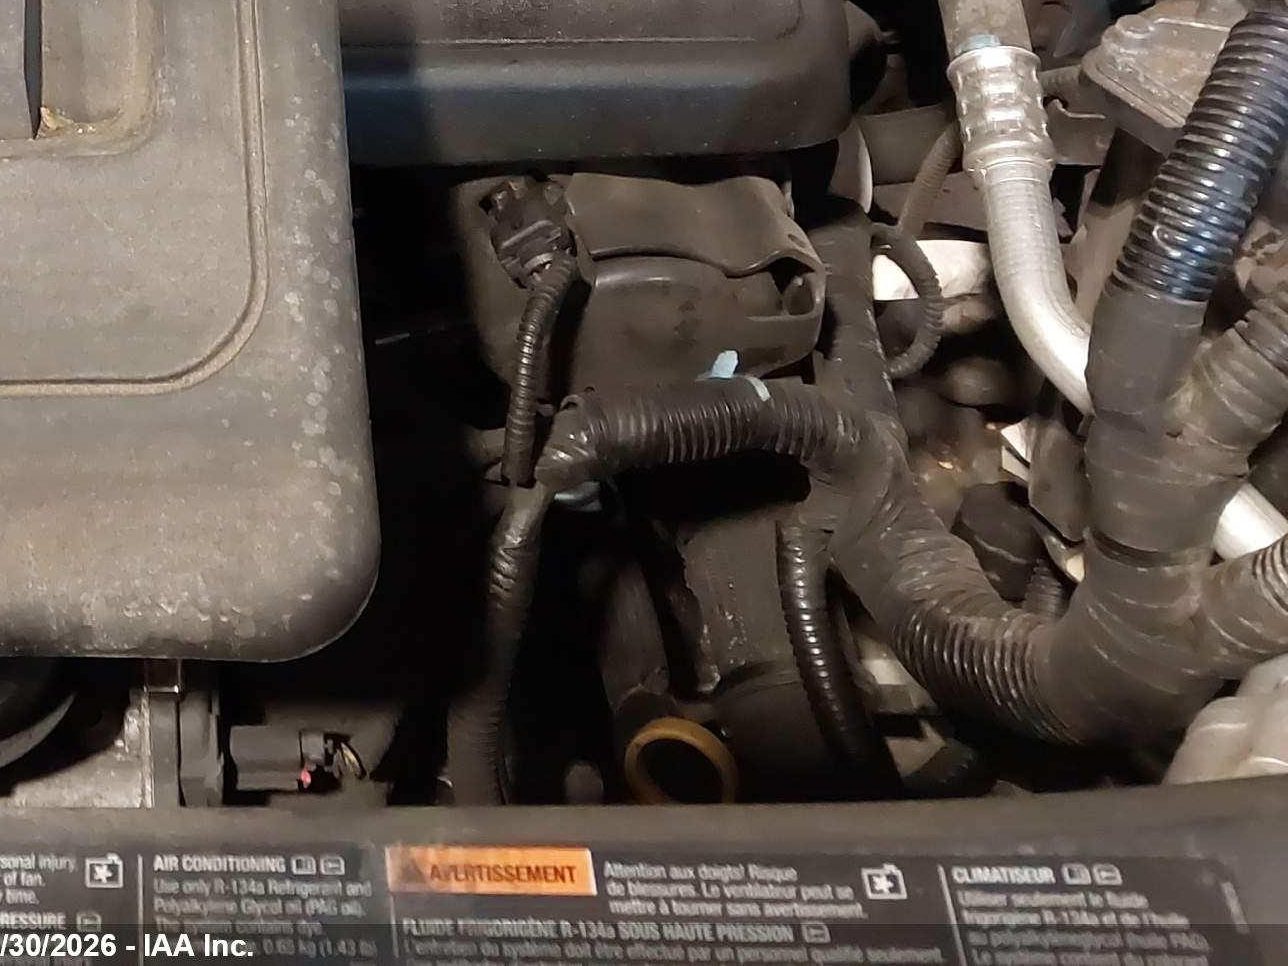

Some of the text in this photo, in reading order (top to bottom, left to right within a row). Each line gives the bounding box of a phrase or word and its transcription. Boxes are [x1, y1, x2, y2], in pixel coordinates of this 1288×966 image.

[153, 854, 286, 874] AIR CONDITIONING
[429, 864, 576, 883] AVERTISSEMENT
[604, 861, 666, 879] Attention
[669, 863, 695, 880] aux
[3, 870, 18, 887] of
[20, 871, 47, 887] fan.
[951, 865, 1057, 884] CLIMATISEUR
[5, 888, 41, 905] time.
[606, 881, 626, 897] de
[560, 920, 615, 940] R-134a
[617, 920, 661, 941] SOUS
[661, 921, 715, 942] HAUTE
[715, 922, 795, 944] PRESSION
